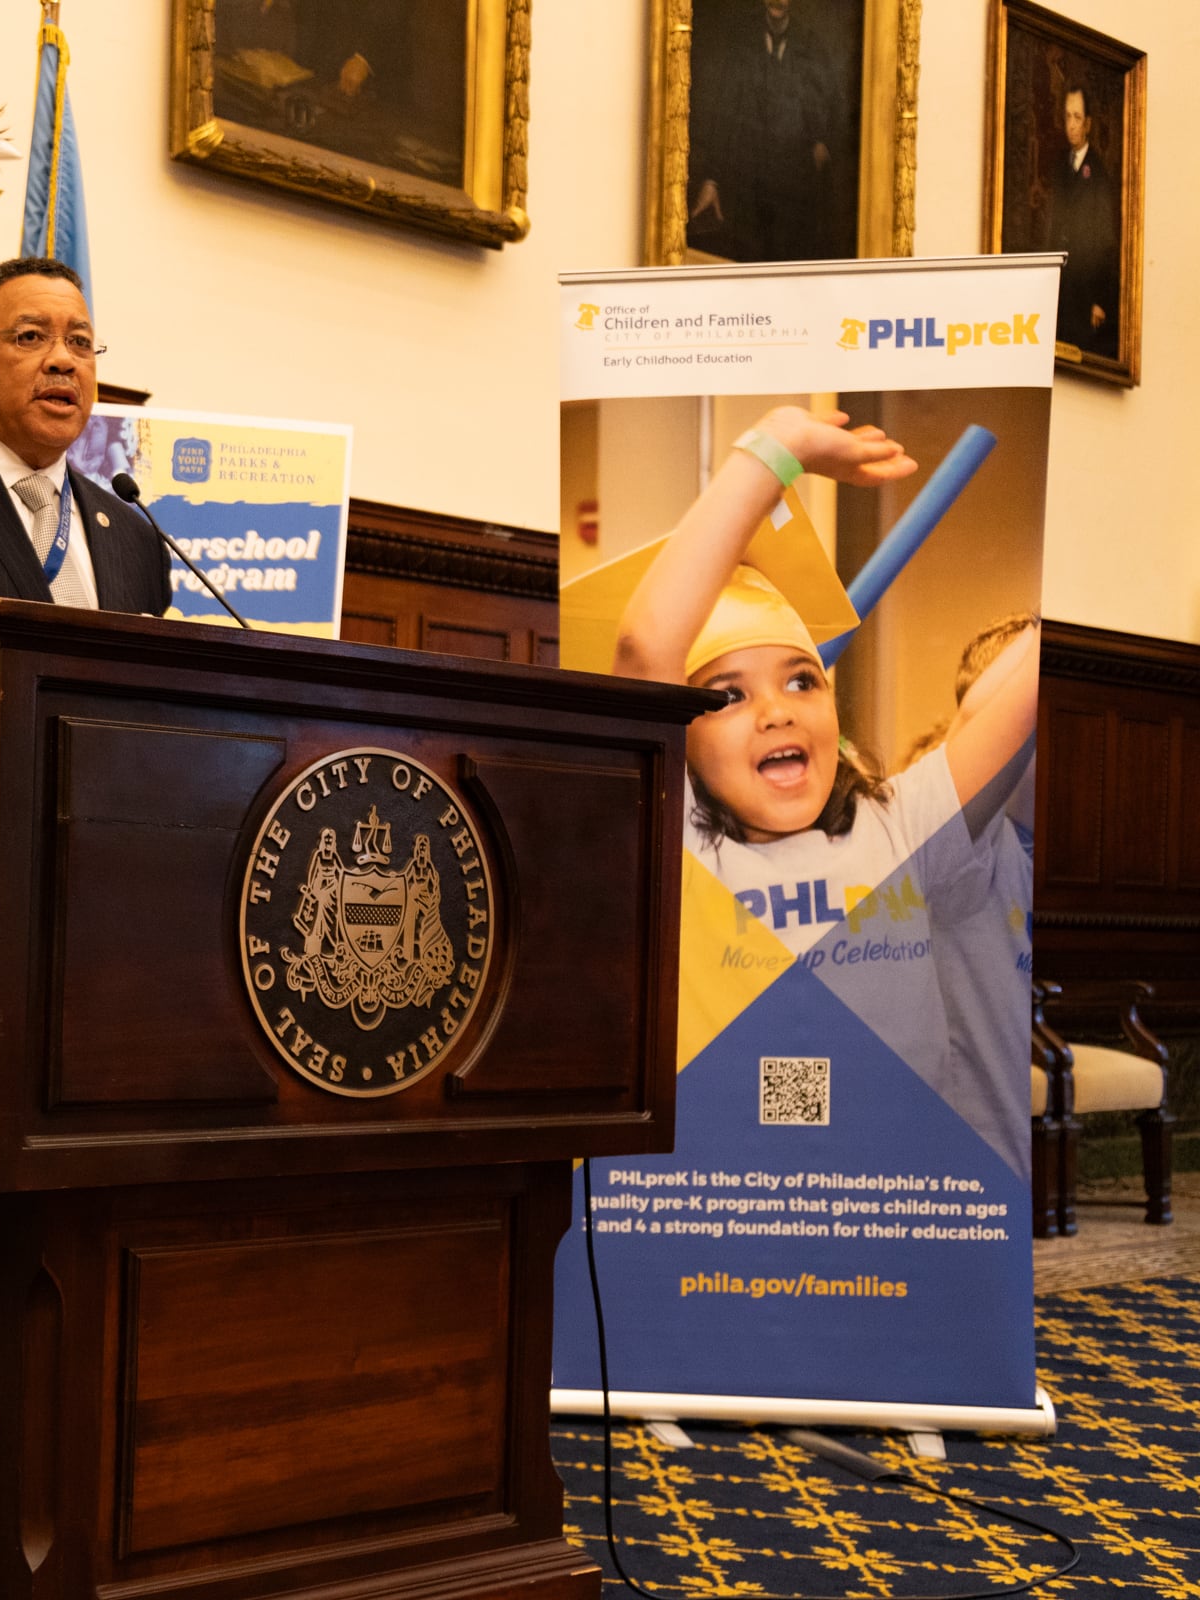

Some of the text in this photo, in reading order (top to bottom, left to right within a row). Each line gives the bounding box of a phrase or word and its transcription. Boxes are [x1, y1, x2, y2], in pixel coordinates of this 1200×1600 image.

[605, 305, 650, 315] Office of
[604, 313, 772, 330] Children and Families
[604, 328, 809, 343] CITY OF PHILADELPHIA
[868, 313, 1040, 355] PHLpreK
[603, 353, 752, 368] Early Childhood Education
[178, 455, 206, 465] YOUR
[220, 443, 307, 457] PHILADELPHIA
[219, 457, 281, 470] PARKS &
[219, 470, 316, 484] RECREATION
[166, 530, 322, 561] erschool
[170, 562, 297, 599] rogram
[248, 757, 488, 1083] SEAL OF THE CITY OF PHILADELPHIA
[609, 1170, 985, 1194] PHLpreK is the City of Philadelphia's free,
[590, 1193, 1008, 1219] quality pre-K program that gives children ages
[597, 1217, 632, 1233] and
[635, 1219, 647, 1233] 4
[650, 1221, 661, 1233] a
[664, 1219, 723, 1237] strong
[727, 1218, 829, 1237] foundation
[833, 1220, 860, 1237] for
[863, 1220, 909, 1239] their
[911, 1222, 1010, 1241] education.
[680, 1271, 909, 1298] phila.gov/families
